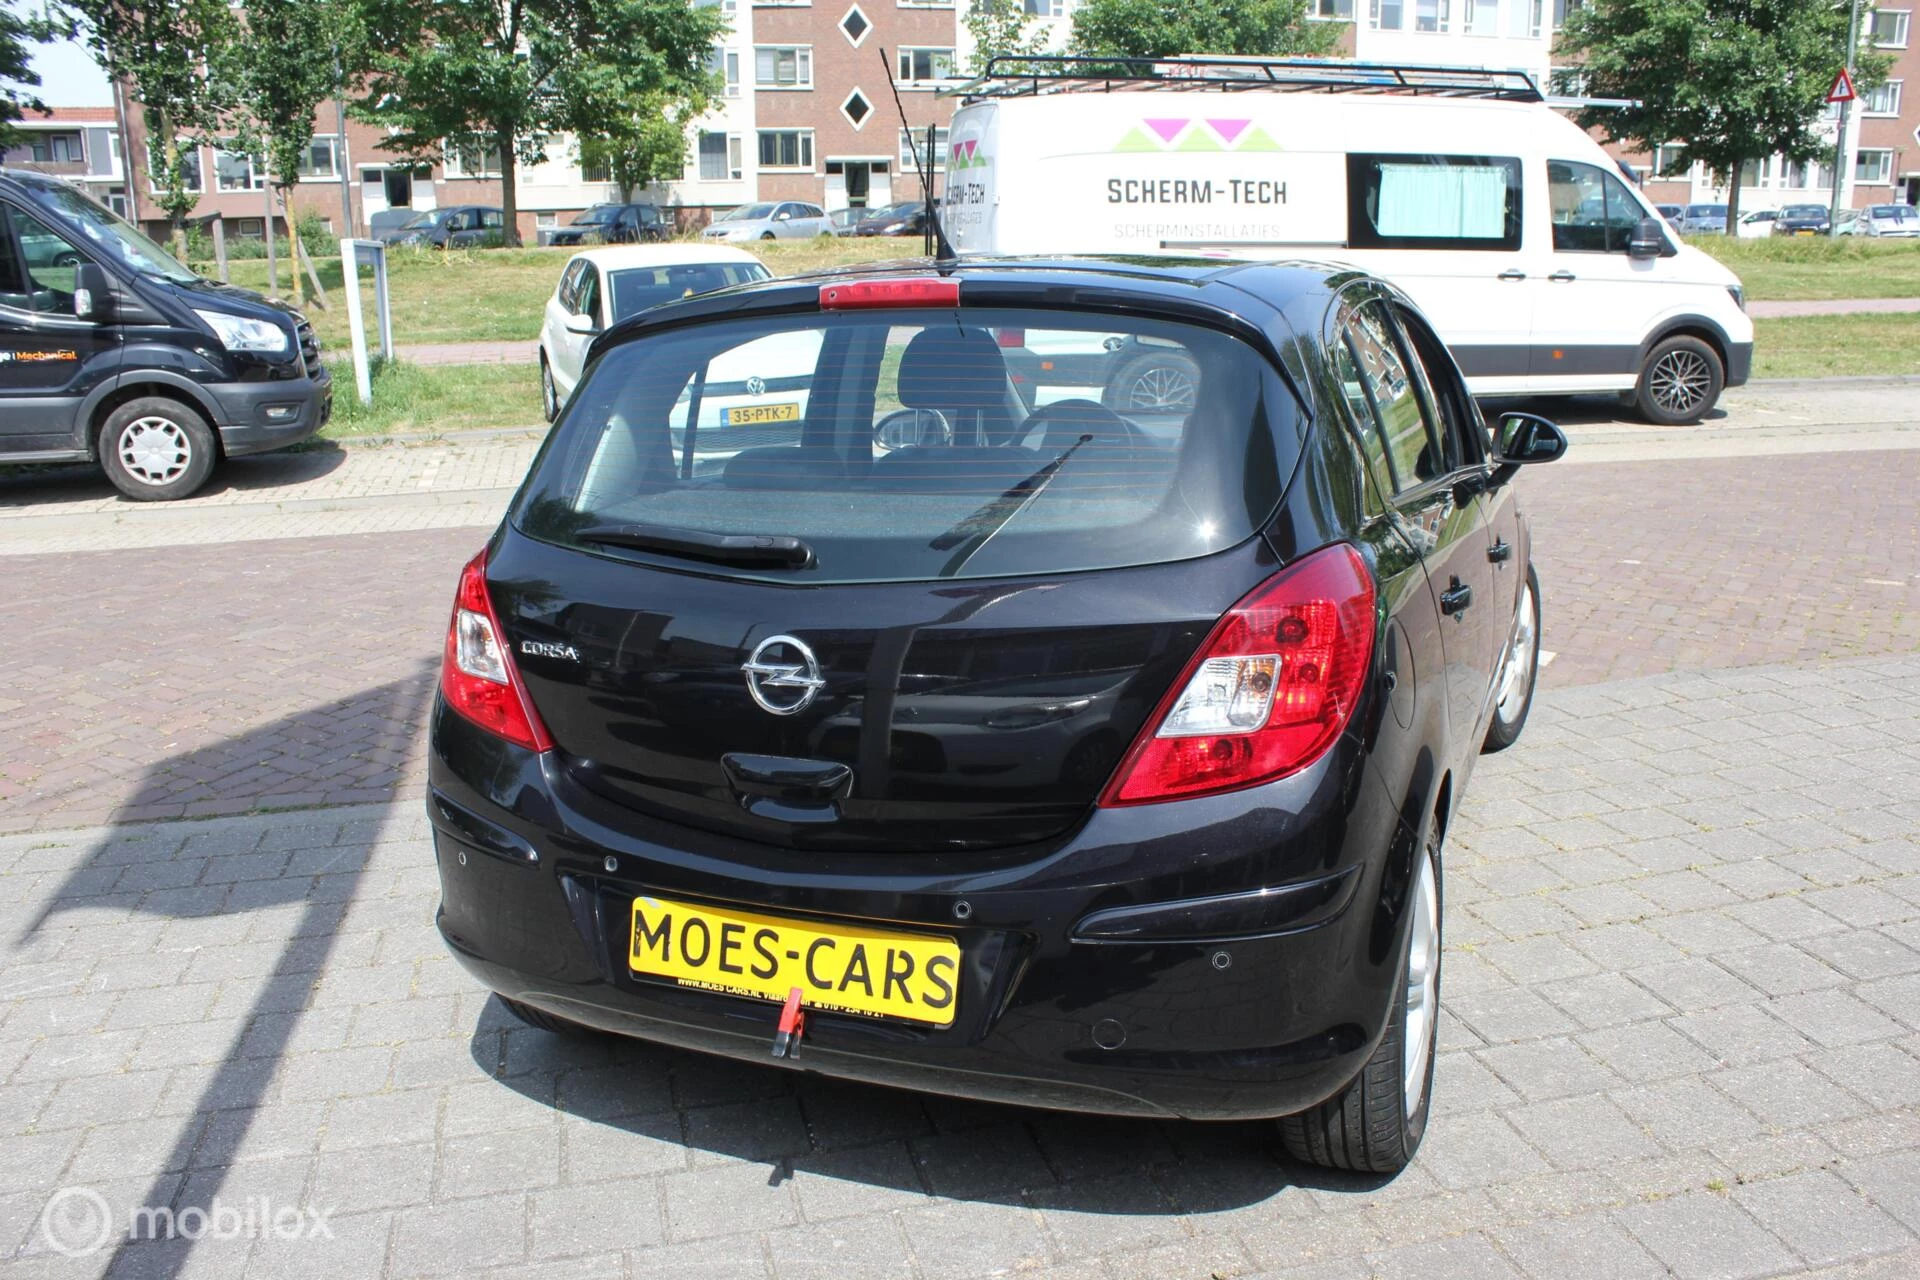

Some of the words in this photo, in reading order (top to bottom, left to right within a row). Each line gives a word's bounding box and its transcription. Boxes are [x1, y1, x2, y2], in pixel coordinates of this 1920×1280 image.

[1107, 178, 1287, 204] SCHERM-TECH
[1113, 223, 1281, 239] SCHERMINSTALLATIES
[733, 406, 793, 423] 35-PTK-7
[520, 640, 578, 661] CORSA
[634, 909, 956, 1008] MOES-CARS
